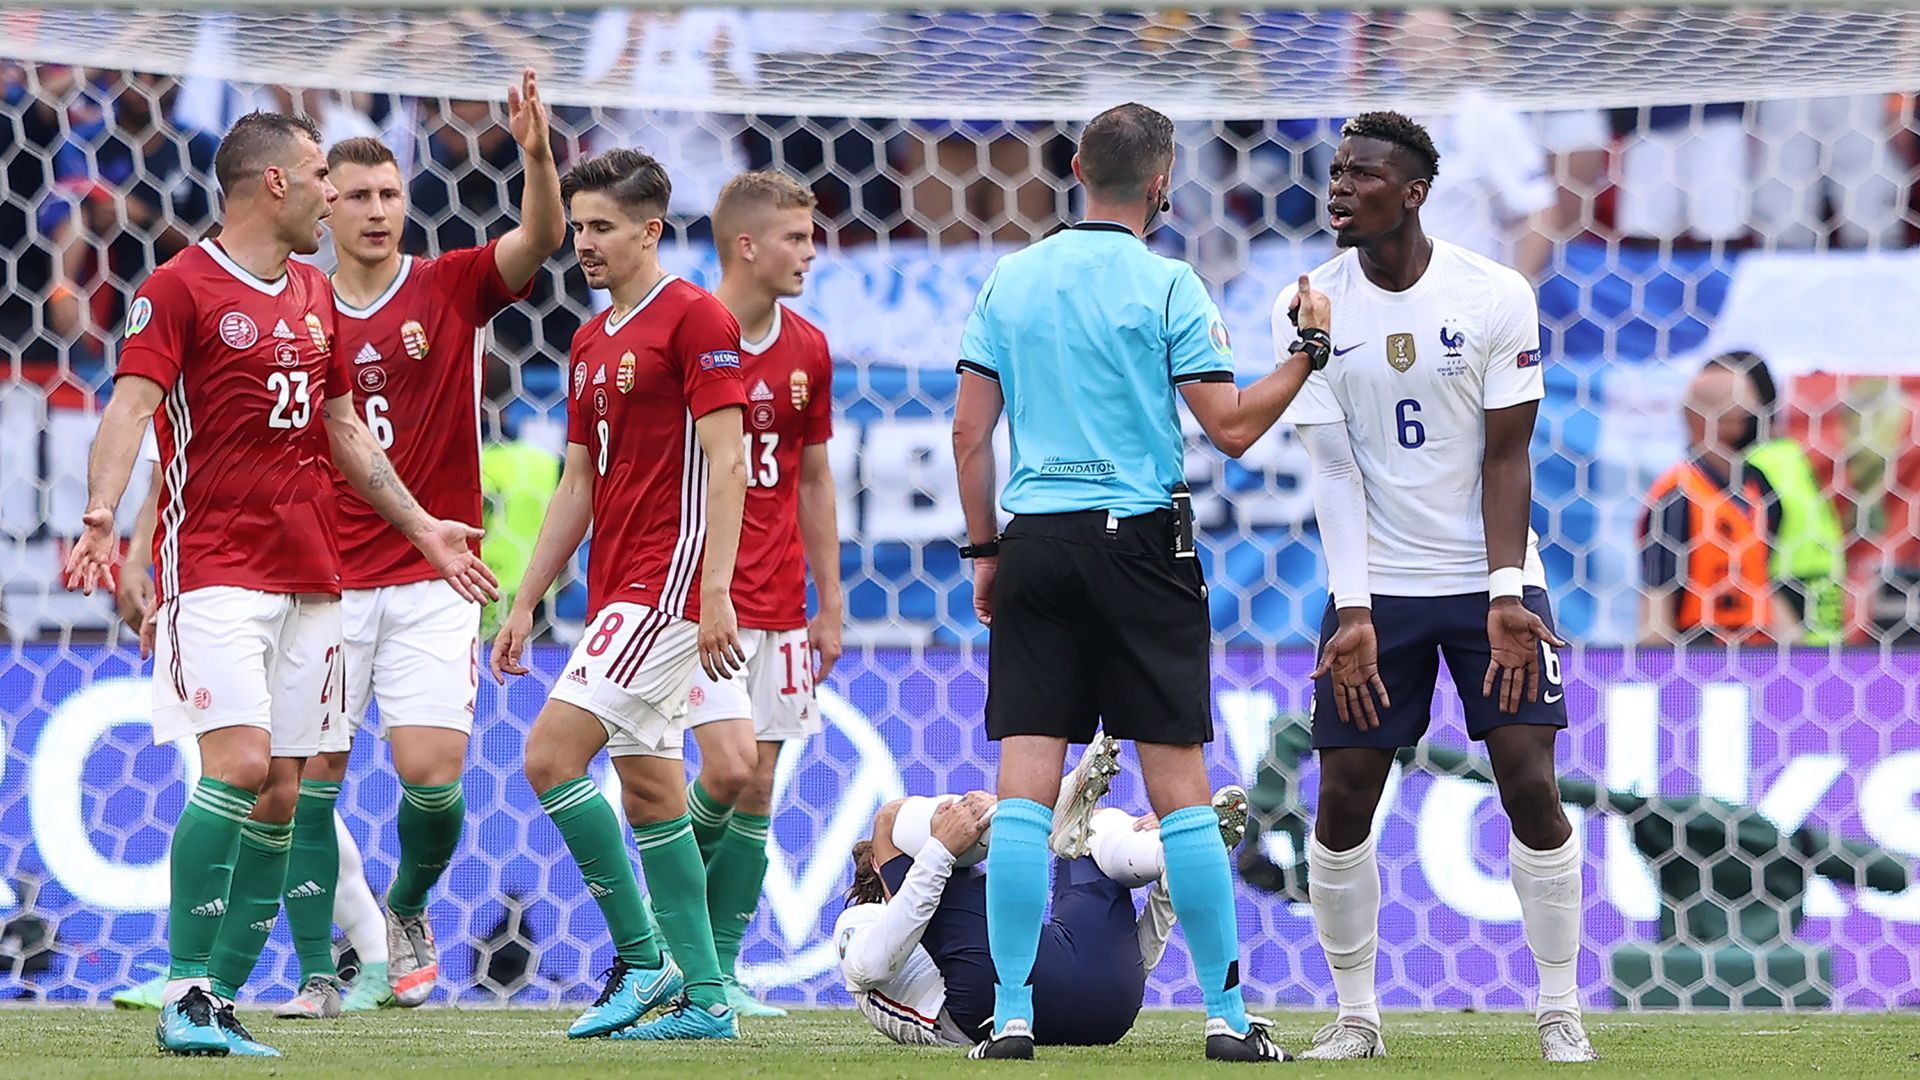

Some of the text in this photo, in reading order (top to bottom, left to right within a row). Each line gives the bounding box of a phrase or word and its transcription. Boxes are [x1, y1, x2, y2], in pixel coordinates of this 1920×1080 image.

[267, 371, 310, 428] 23
[365, 395, 394, 450] 6
[1395, 399, 1426, 449] 6
[597, 420, 609, 477] 8
[742, 432, 780, 488] 13
[1040, 463, 1116, 473] FOUNDATION
[586, 612, 624, 657] 8
[321, 644, 340, 704] 2
[1541, 640, 1562, 686] 6
